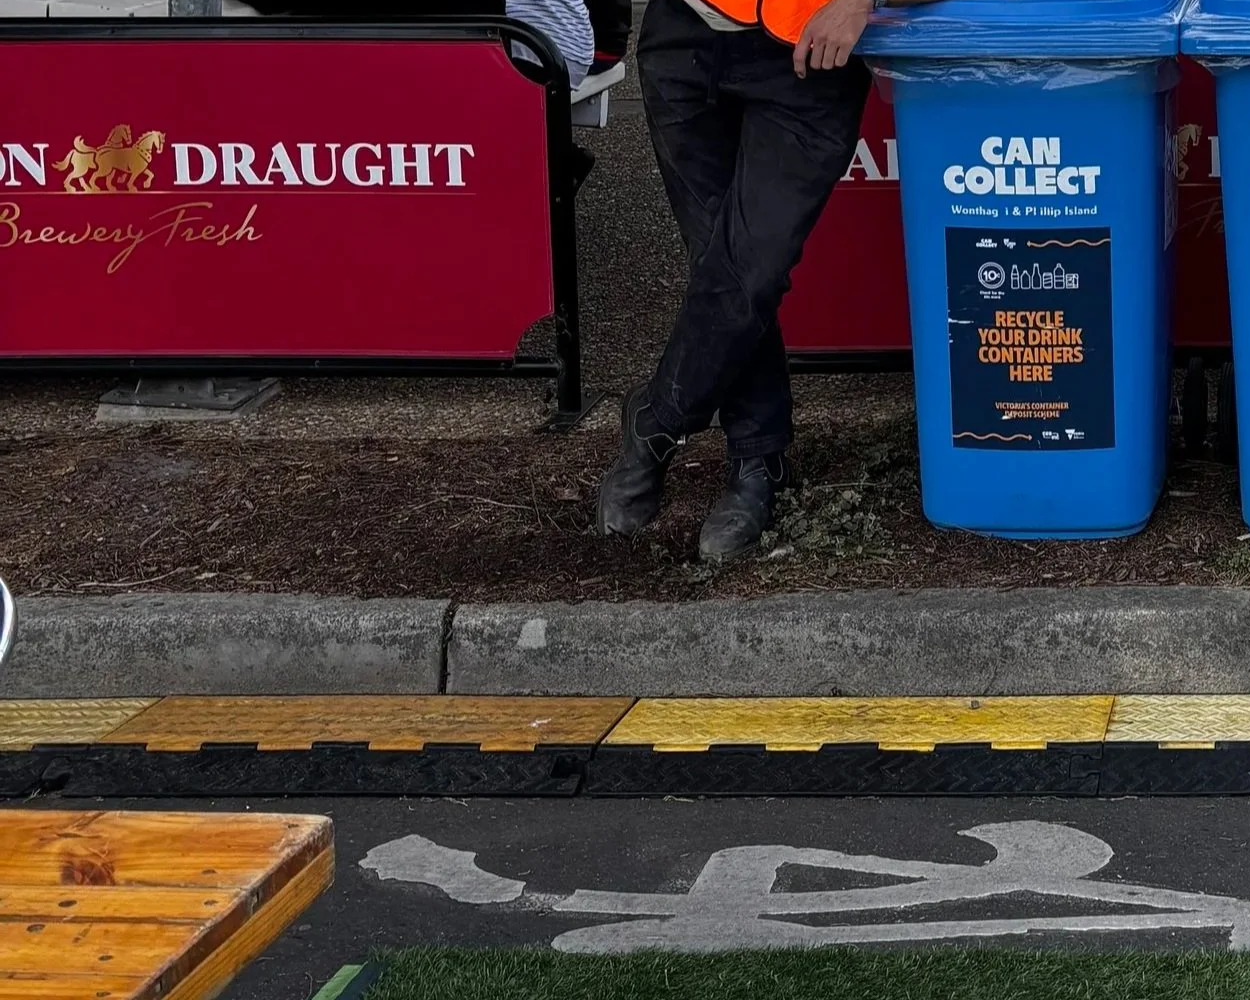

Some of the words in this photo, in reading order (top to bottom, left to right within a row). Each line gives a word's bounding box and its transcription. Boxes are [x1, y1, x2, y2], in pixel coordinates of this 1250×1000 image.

[981, 136, 1061, 166] CAN
[171, 141, 475, 186] DRAUGHT
[943, 165, 1101, 195] COLLECT
[1012, 207, 1022, 217] &
[1065, 205, 1098, 216] Island
[149, 202, 262, 247] Fresh
[995, 311, 1064, 328] RECYCLE
[978, 328, 1025, 345] YOUR
[1028, 327, 1083, 345] DRINK
[978, 346, 1084, 363] CONTAINERS
[1009, 365, 1053, 382] HERE
[1031, 402, 1069, 410] CONTAINER
